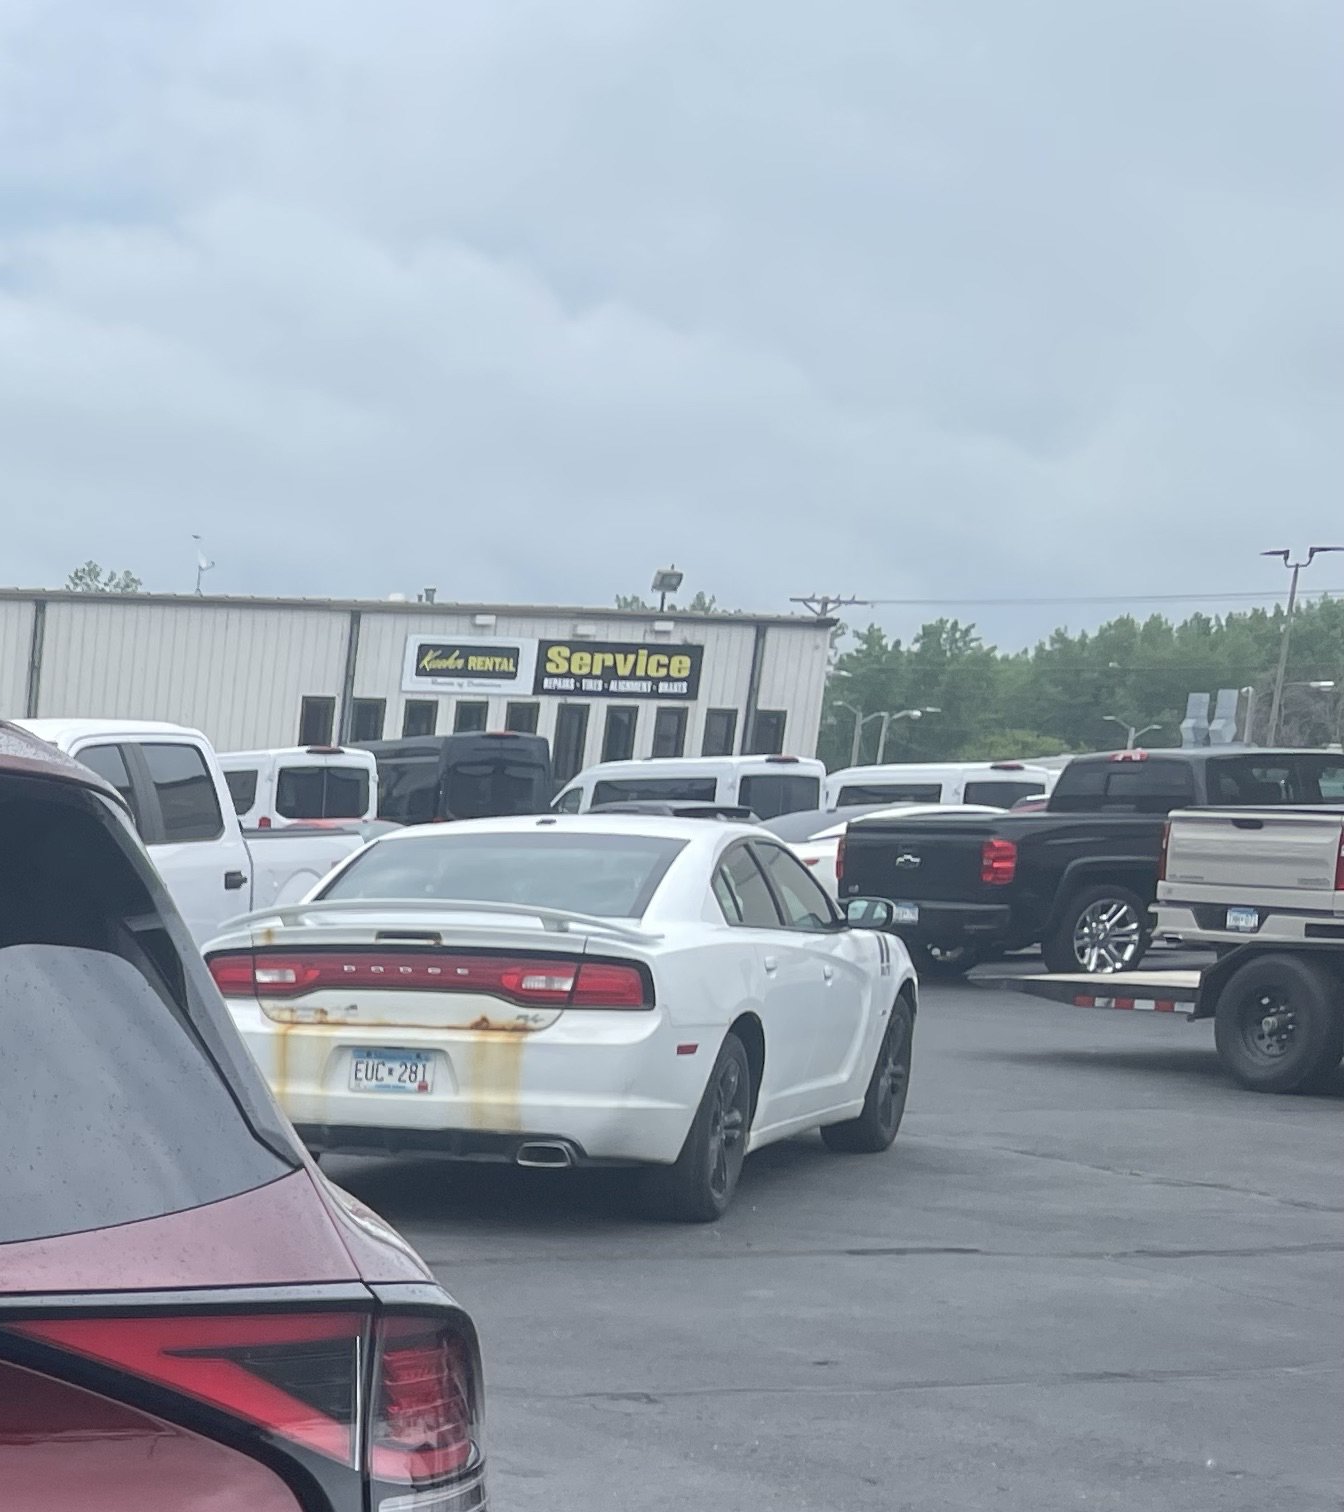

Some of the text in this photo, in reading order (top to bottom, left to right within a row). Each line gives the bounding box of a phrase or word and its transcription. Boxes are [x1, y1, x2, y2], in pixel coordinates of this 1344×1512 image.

[467, 655, 517, 673] RENTAL
[545, 645, 692, 678] Service
[609, 679, 653, 693] ALIGNMENT
